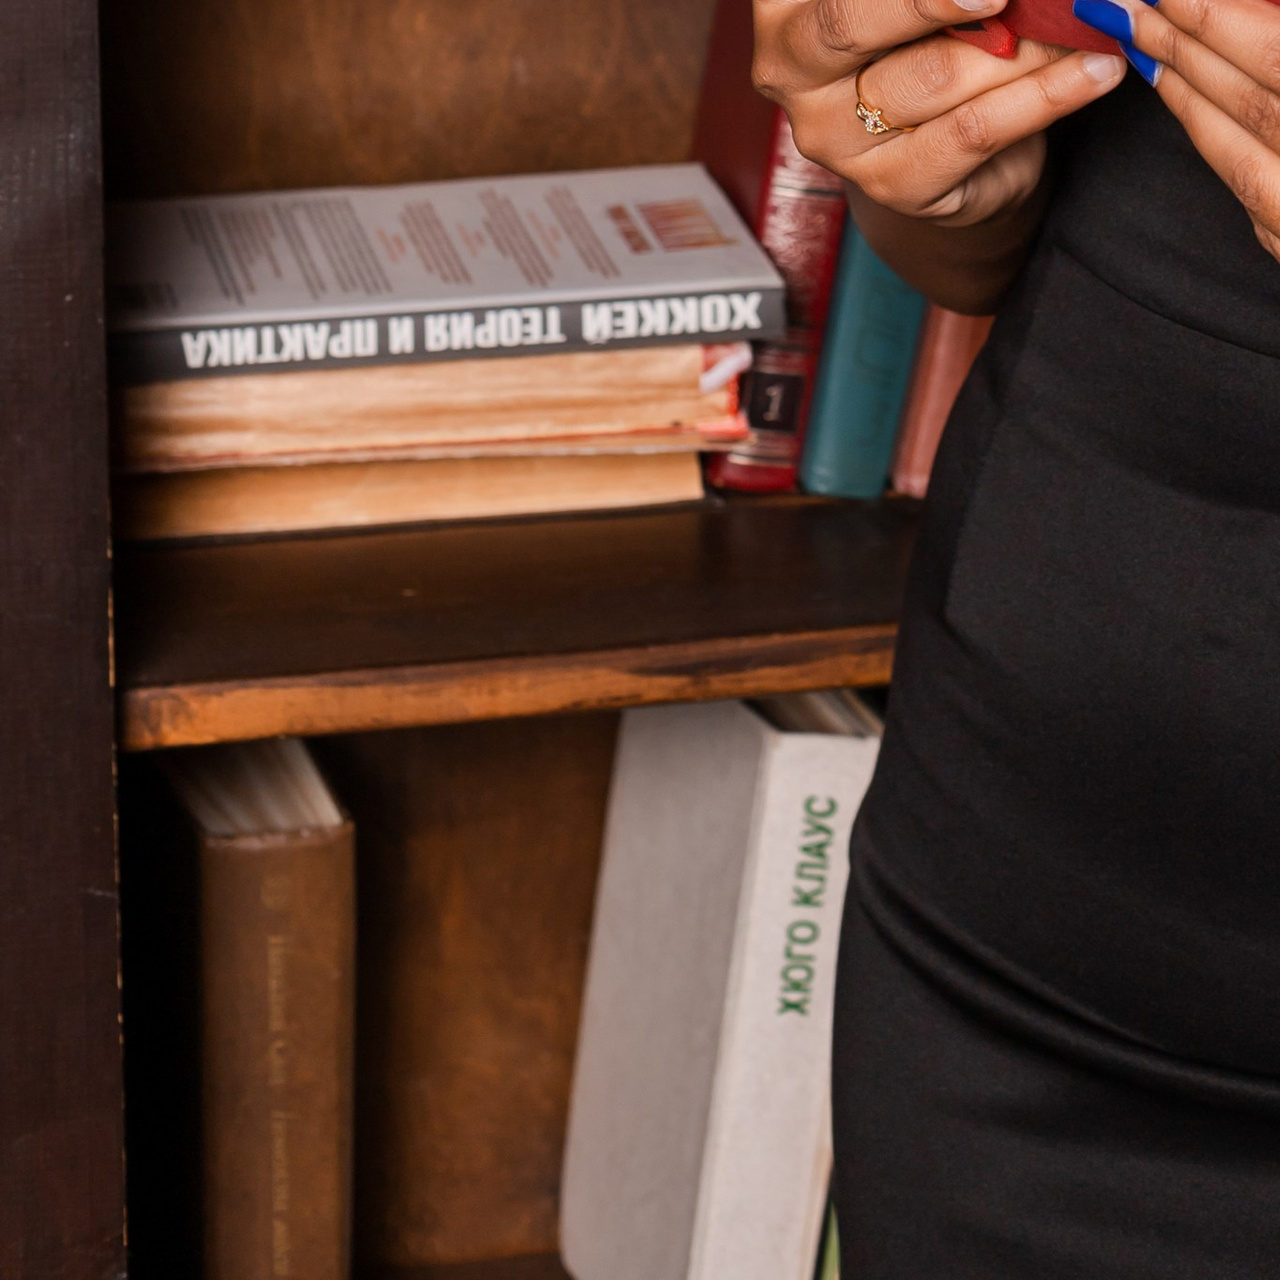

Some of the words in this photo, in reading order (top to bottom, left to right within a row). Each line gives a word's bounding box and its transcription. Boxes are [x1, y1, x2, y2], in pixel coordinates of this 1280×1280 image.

[181, 318, 378, 369] ПРАКТИКА
[388, 315, 415, 355] И
[425, 304, 566, 352] ТЕОРИЯ
[582, 292, 763, 345] ХОККЕЙ
[790, 794, 839, 908] КЛАУС
[777, 919, 821, 1017] ХЮГО
